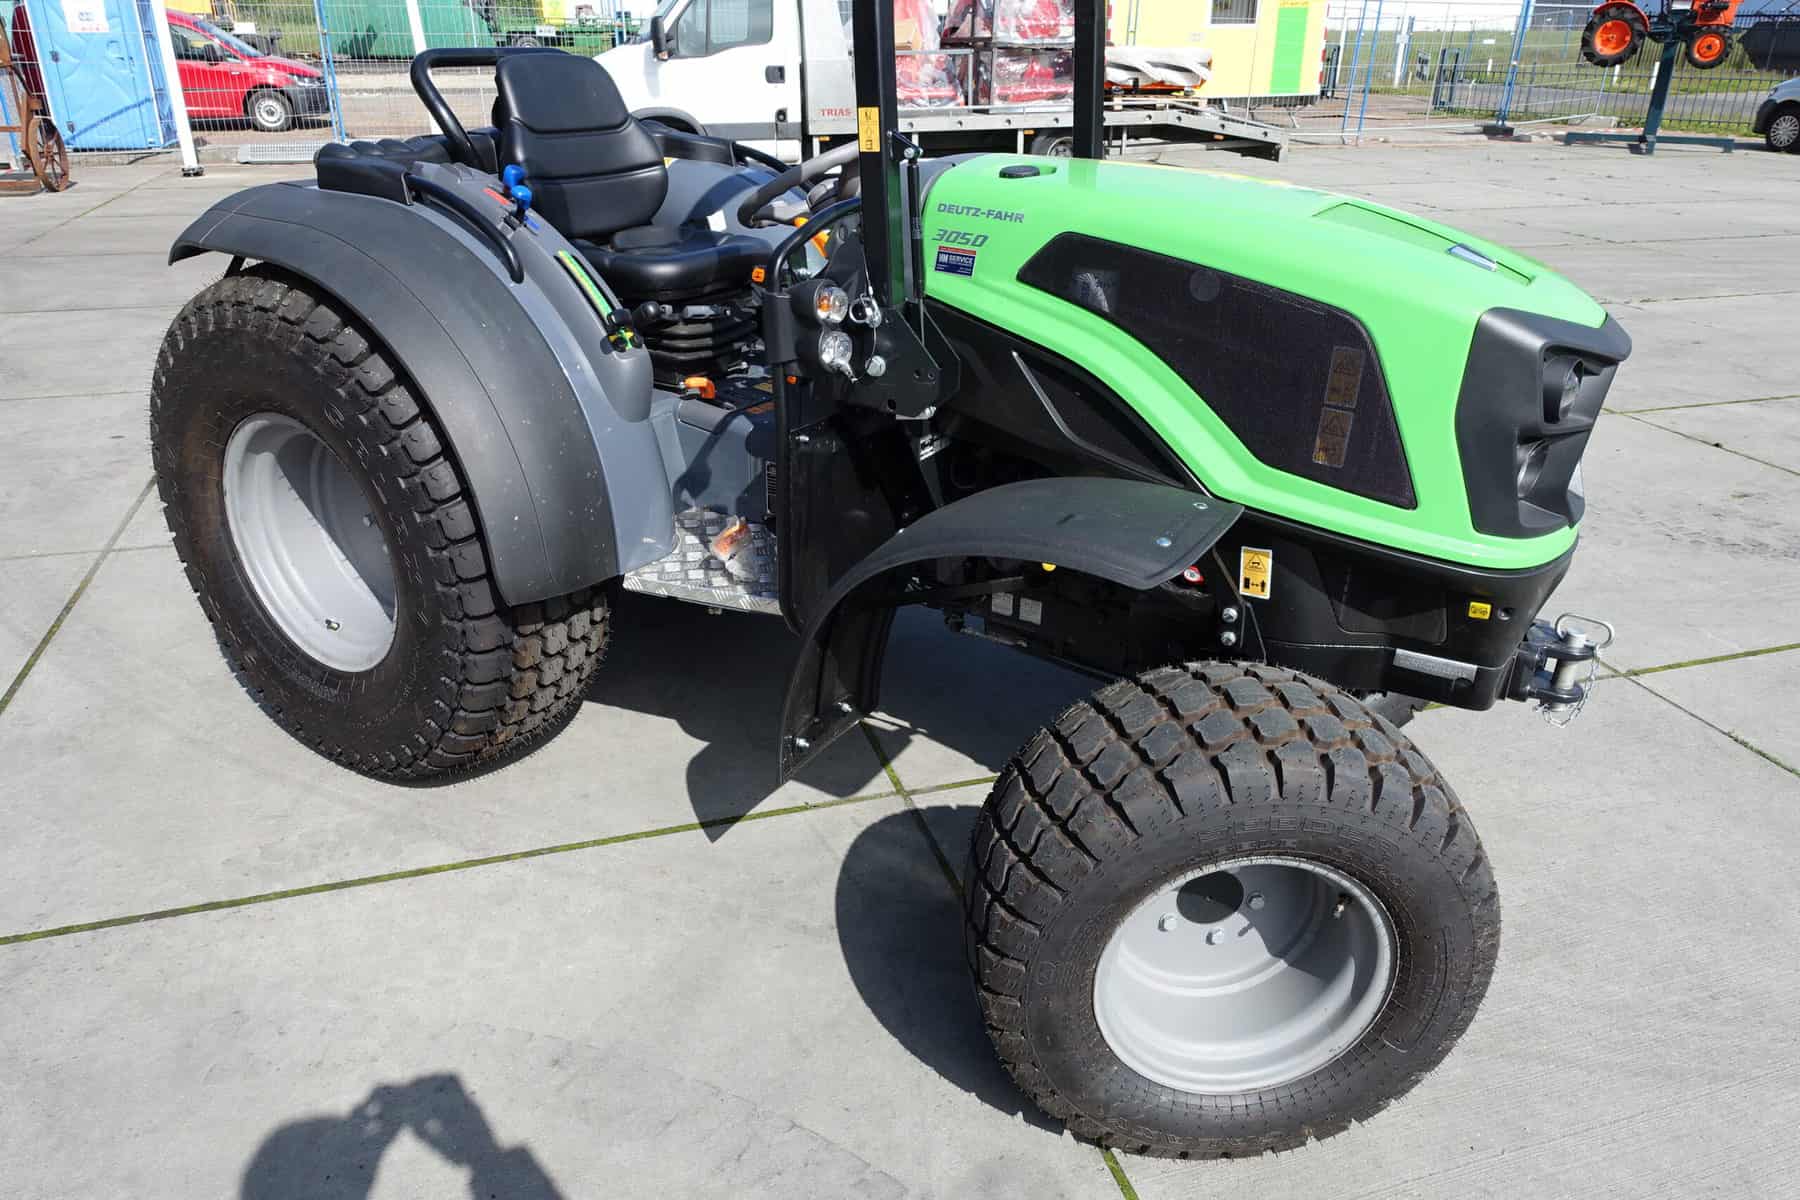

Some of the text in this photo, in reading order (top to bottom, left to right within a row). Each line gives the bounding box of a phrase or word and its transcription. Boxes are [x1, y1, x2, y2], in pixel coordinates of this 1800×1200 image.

[820, 108, 852, 117] TRIAS
[937, 203, 1024, 223] DEUTZ-FAHR
[932, 229, 988, 247] 3050
